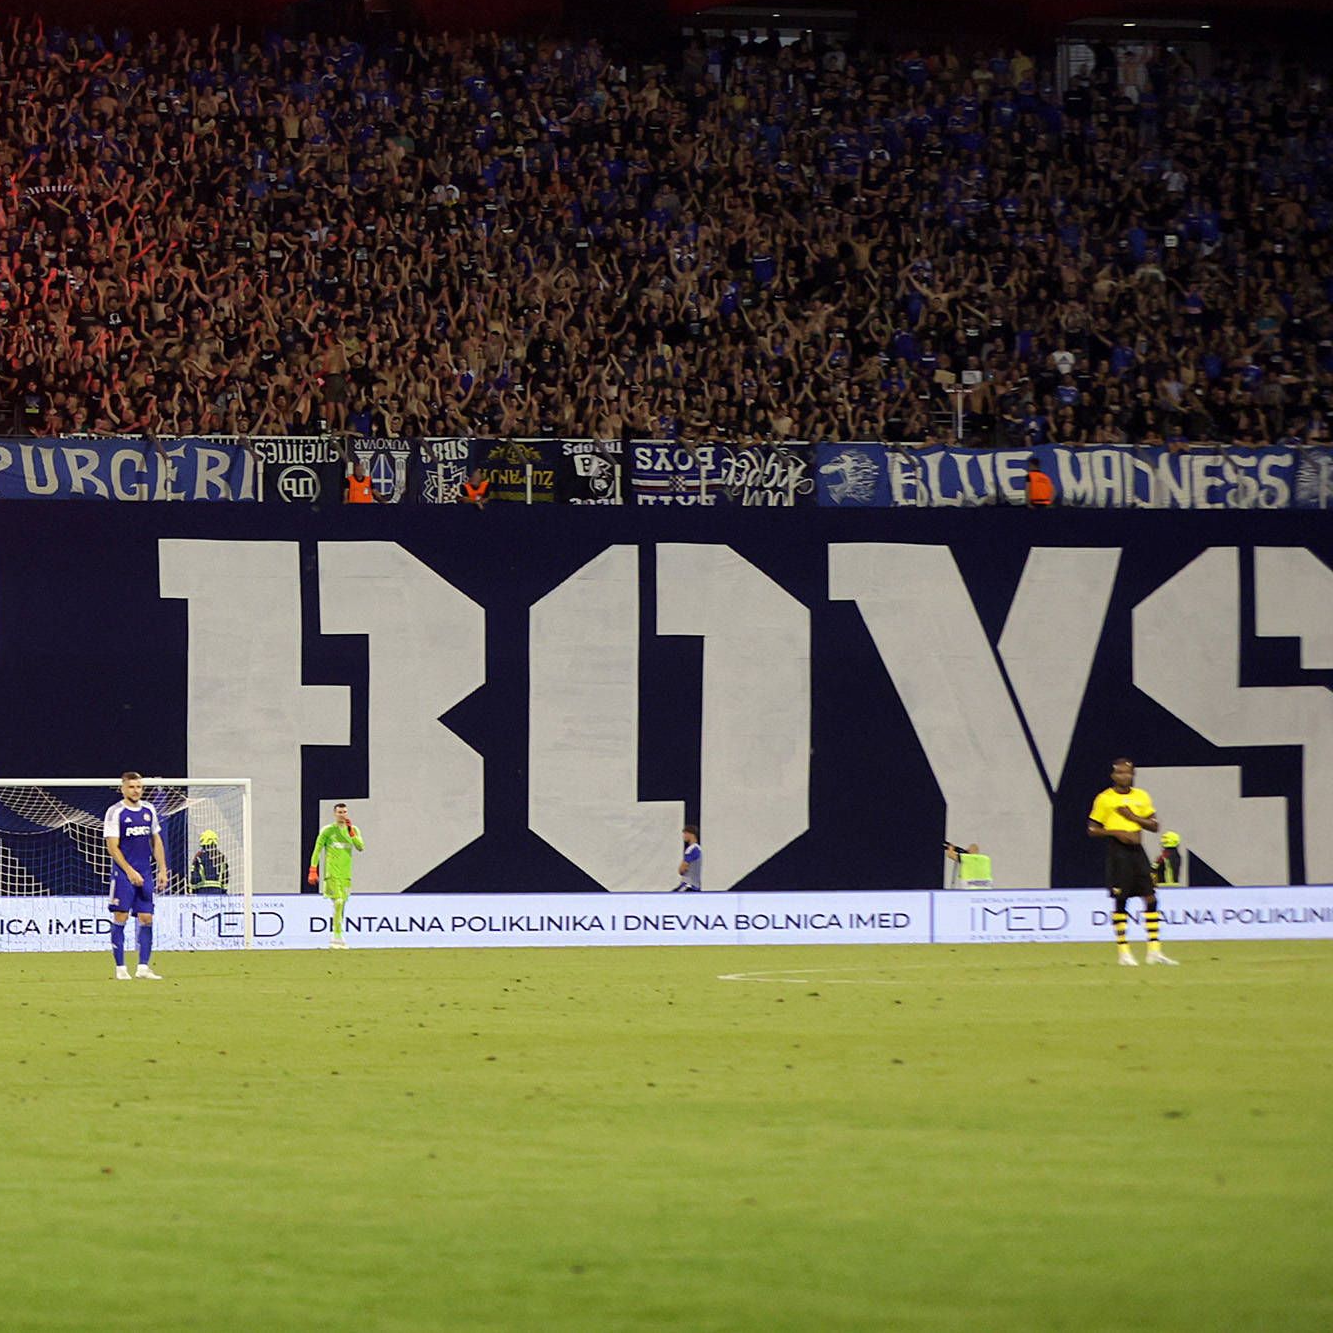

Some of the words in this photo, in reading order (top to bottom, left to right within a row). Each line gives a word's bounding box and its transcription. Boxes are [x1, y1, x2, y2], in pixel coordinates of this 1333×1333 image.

[353, 438, 410, 451] VUKOVAR
[884, 450, 1033, 507] BLUE
[1053, 448, 1294, 509] MADNESS
[159, 539, 1333, 895] BOYS
[48, 918, 113, 936] IMED
[451, 914, 606, 933] POLIKLINIKA
[624, 914, 729, 932] DNEVNA
[735, 913, 843, 931] BOLNICA
[849, 912, 911, 929] IMED
